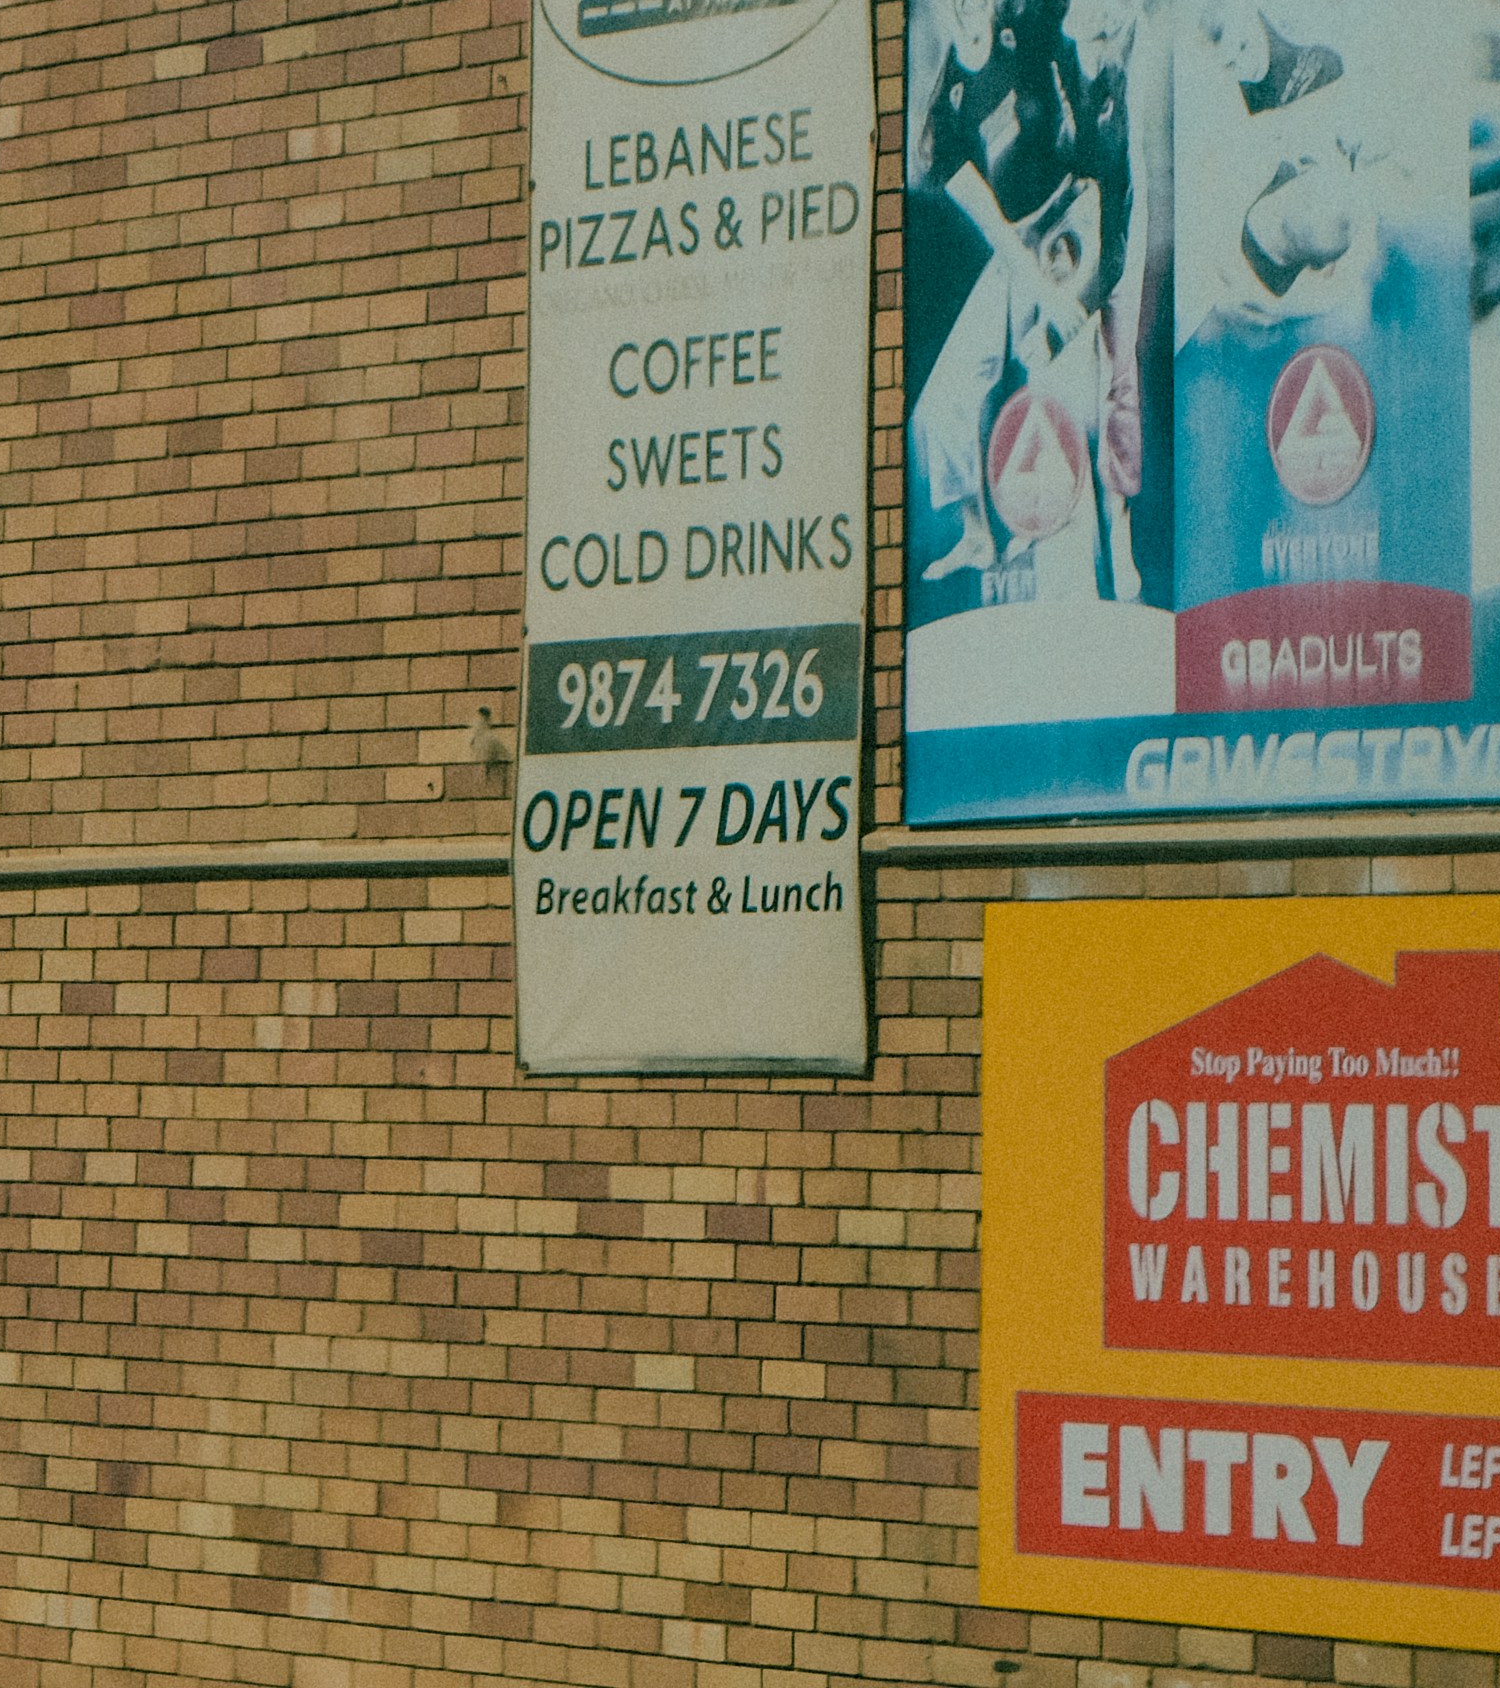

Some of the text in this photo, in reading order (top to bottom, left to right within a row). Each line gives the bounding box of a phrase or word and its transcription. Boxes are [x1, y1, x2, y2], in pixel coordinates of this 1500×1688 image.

[585, 107, 813, 190] LEBANESE
[540, 180, 860, 272] PIZZAS & PIED
[609, 326, 782, 398] COFFEE
[607, 422, 783, 492] SWEETS
[541, 512, 853, 591] COLD DRINKS
[557, 648, 824, 729] 9874 7326
[1220, 629, 1423, 683] GBADULTS
[522, 775, 853, 853] OPEN 7 DAYS
[536, 870, 844, 915] Breakfast & Lunch
[1190, 1046, 1460, 1085] Stop Paying Too Much!!
[1060, 1422, 1390, 1546] ENTRY
